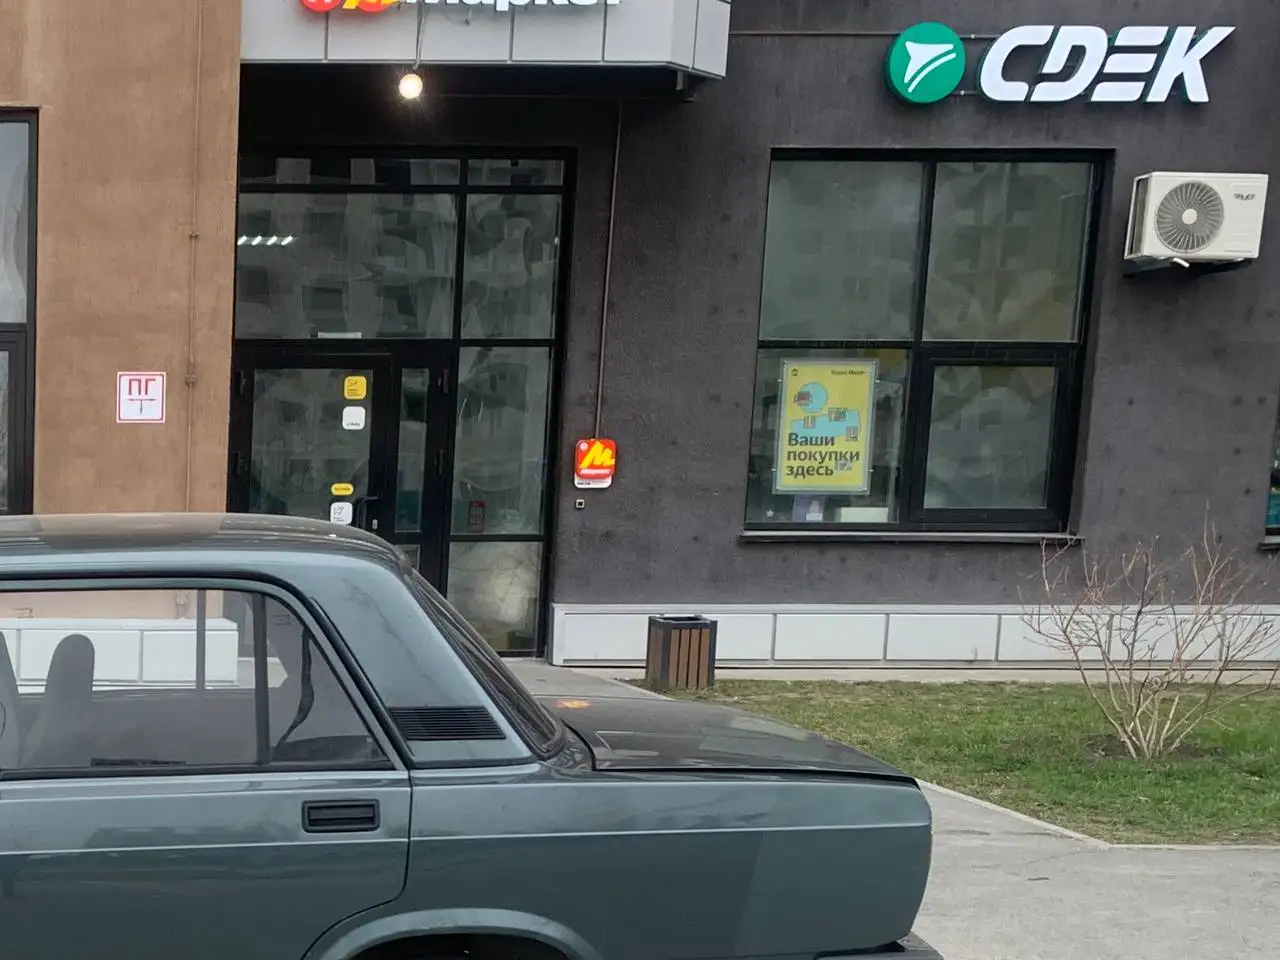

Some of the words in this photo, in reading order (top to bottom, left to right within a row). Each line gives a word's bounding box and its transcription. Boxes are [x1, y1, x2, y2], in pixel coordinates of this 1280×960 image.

[978, 25, 1236, 102] CDEK
[128, 378, 156, 396] ПГ
[788, 432, 835, 447] Ваши
[787, 450, 860, 464] покупки
[785, 464, 834, 479] здесь
